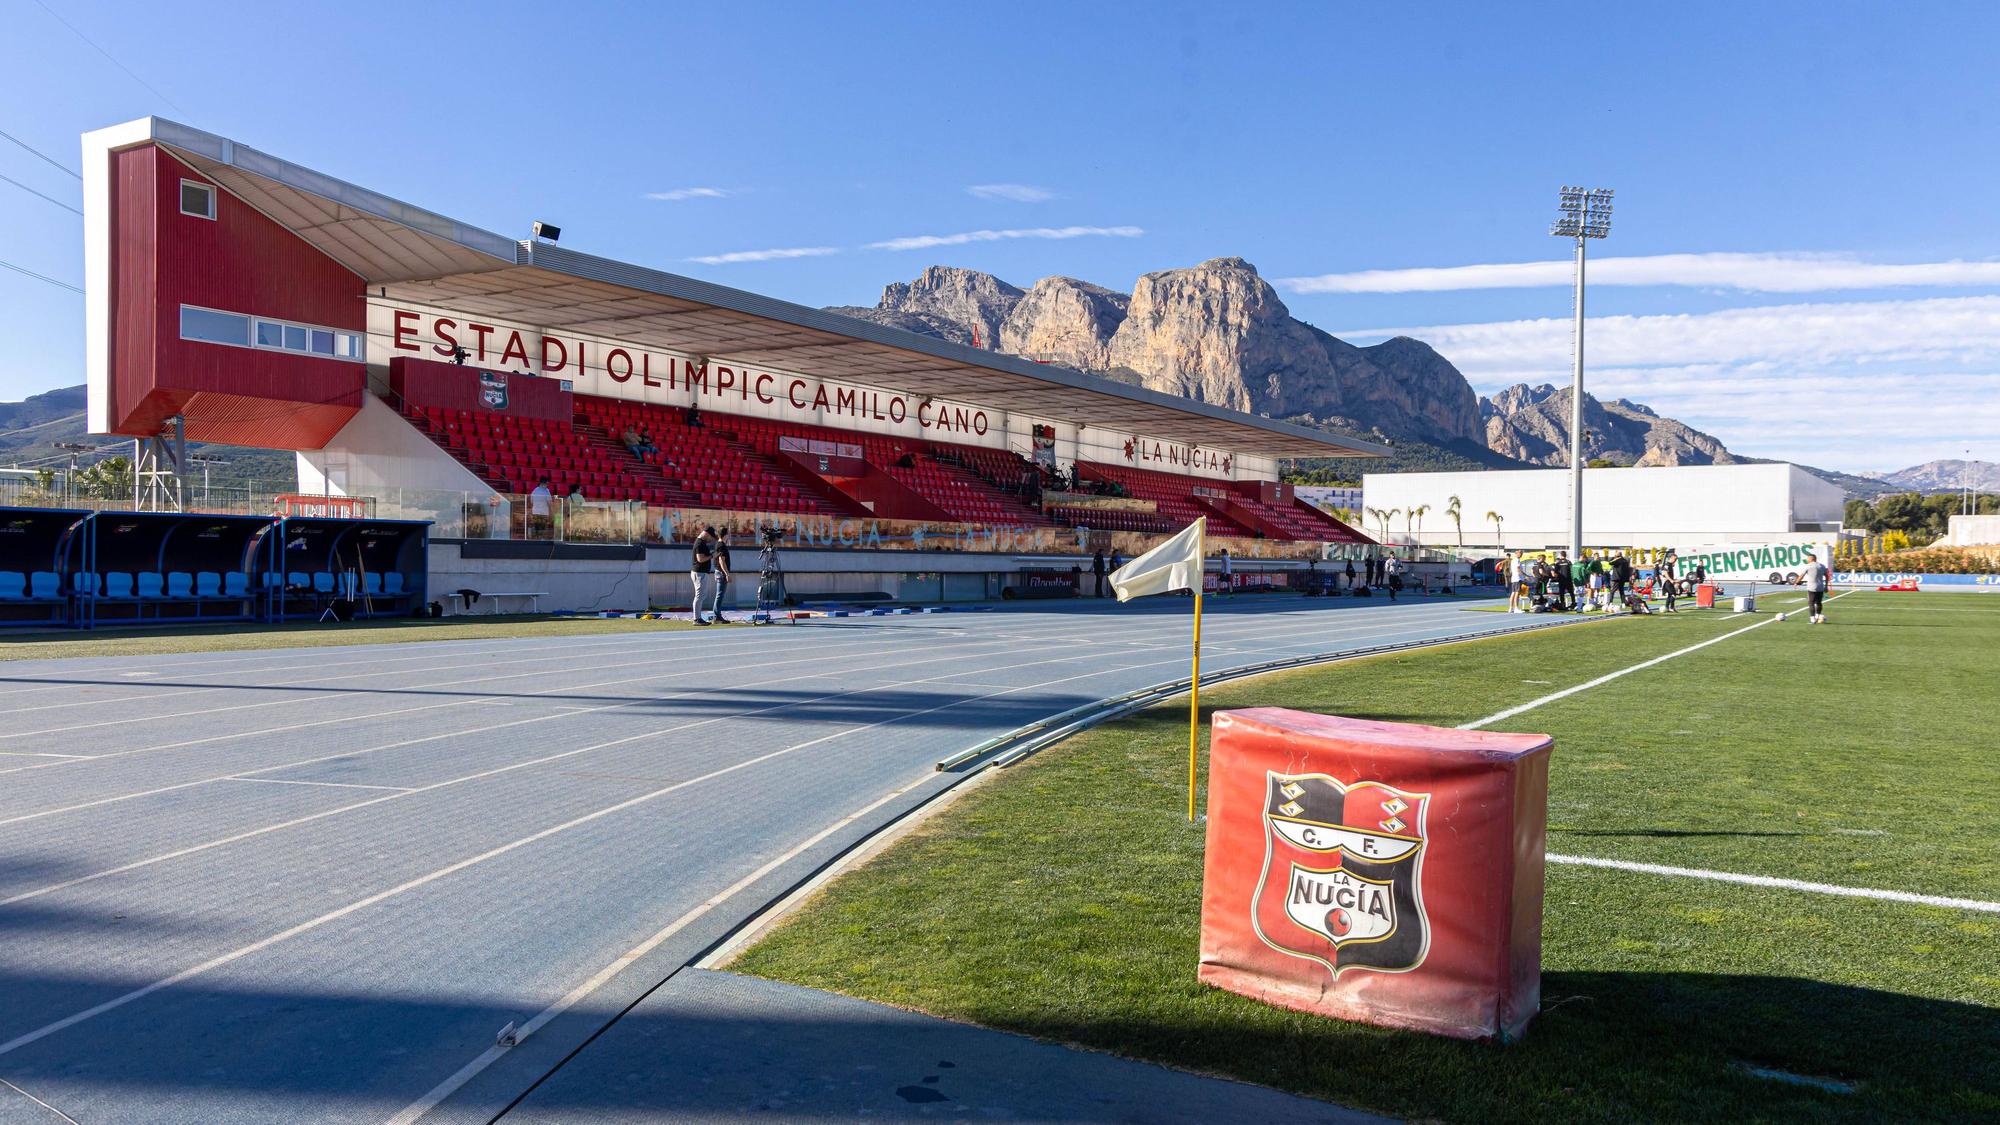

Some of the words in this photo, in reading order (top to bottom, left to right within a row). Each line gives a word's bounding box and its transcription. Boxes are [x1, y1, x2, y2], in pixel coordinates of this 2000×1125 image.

[394, 310, 585, 376] ESTADI
[607, 349, 774, 404] OLIMPIC
[789, 379, 906, 424] CAMILO
[918, 401, 988, 436] CANO
[1142, 439, 1163, 462] LA
[1170, 444, 1218, 471] NUCIA
[1677, 544, 1814, 577] FERENCVÁROS
[1837, 573, 1885, 584] CAMILO
[1303, 829, 1321, 846] C.
[1363, 838, 1379, 855] F.
[1334, 874, 1350, 886] LA
[1293, 875, 1390, 921] NUCÍA
